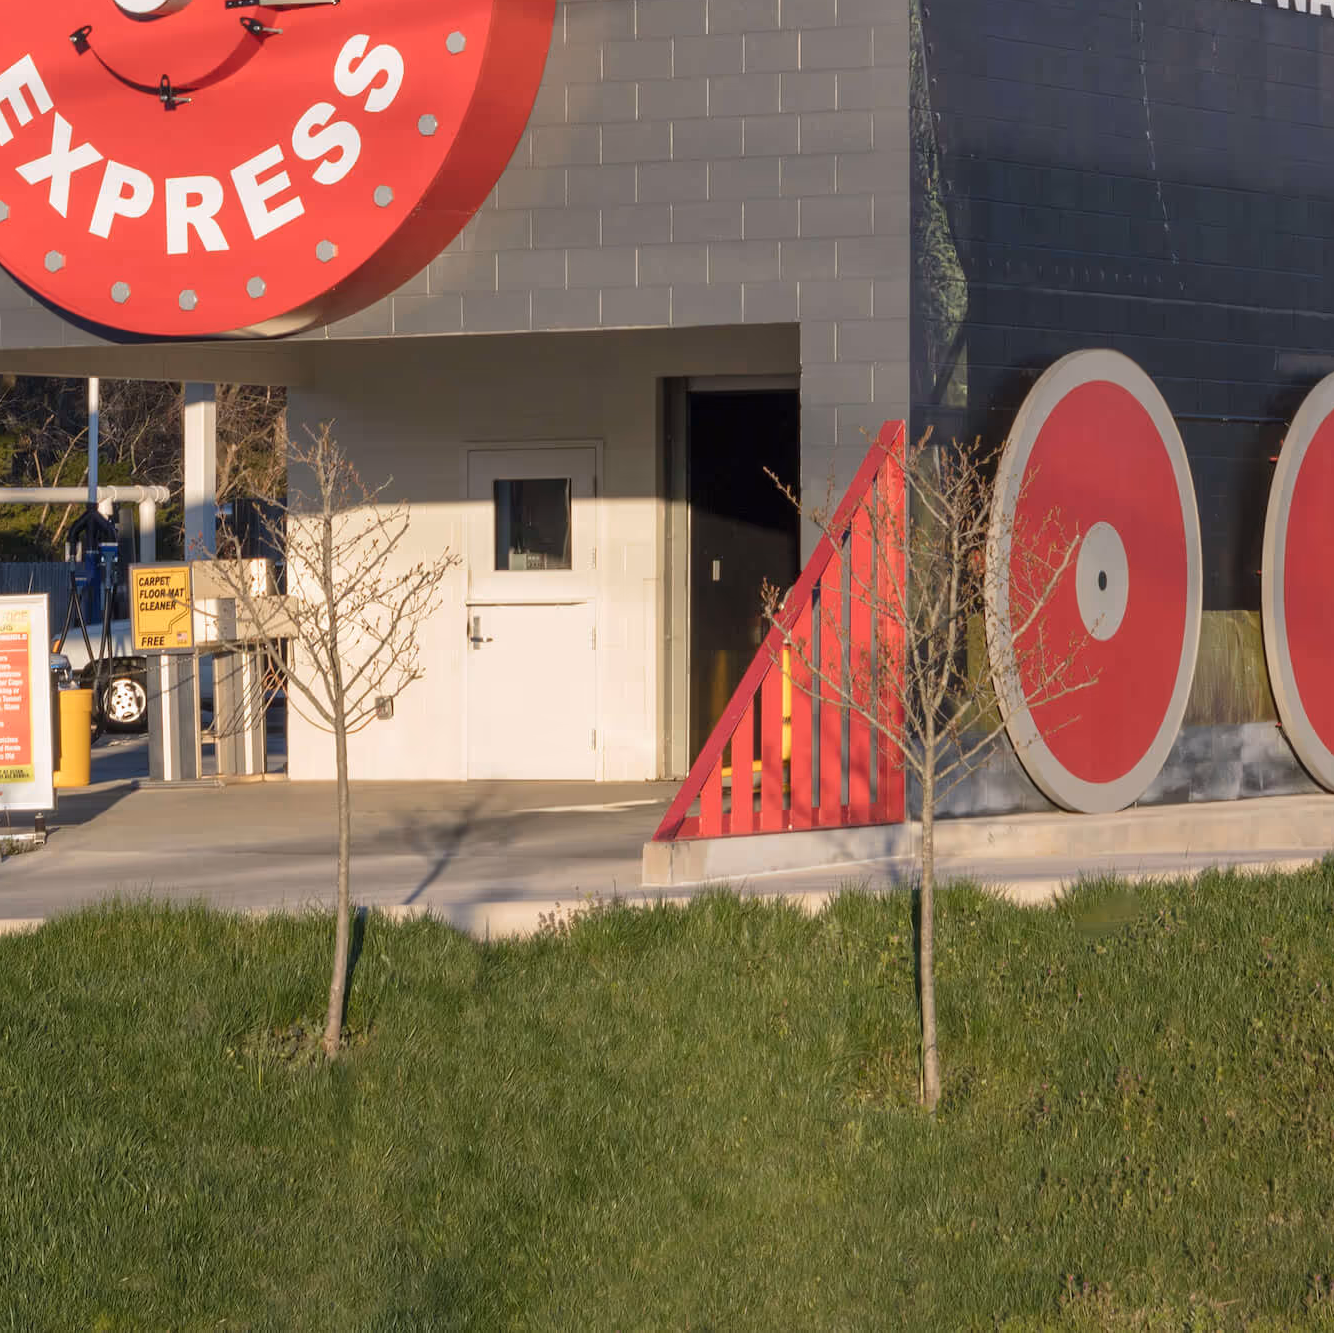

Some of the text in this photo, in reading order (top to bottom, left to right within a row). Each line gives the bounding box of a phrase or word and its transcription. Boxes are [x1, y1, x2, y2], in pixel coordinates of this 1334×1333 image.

[139, 577, 171, 586] CARPET
[140, 588, 185, 599] FLOOR MAT
[140, 601, 177, 611] CLEANER
[141, 636, 165, 646] FREE
